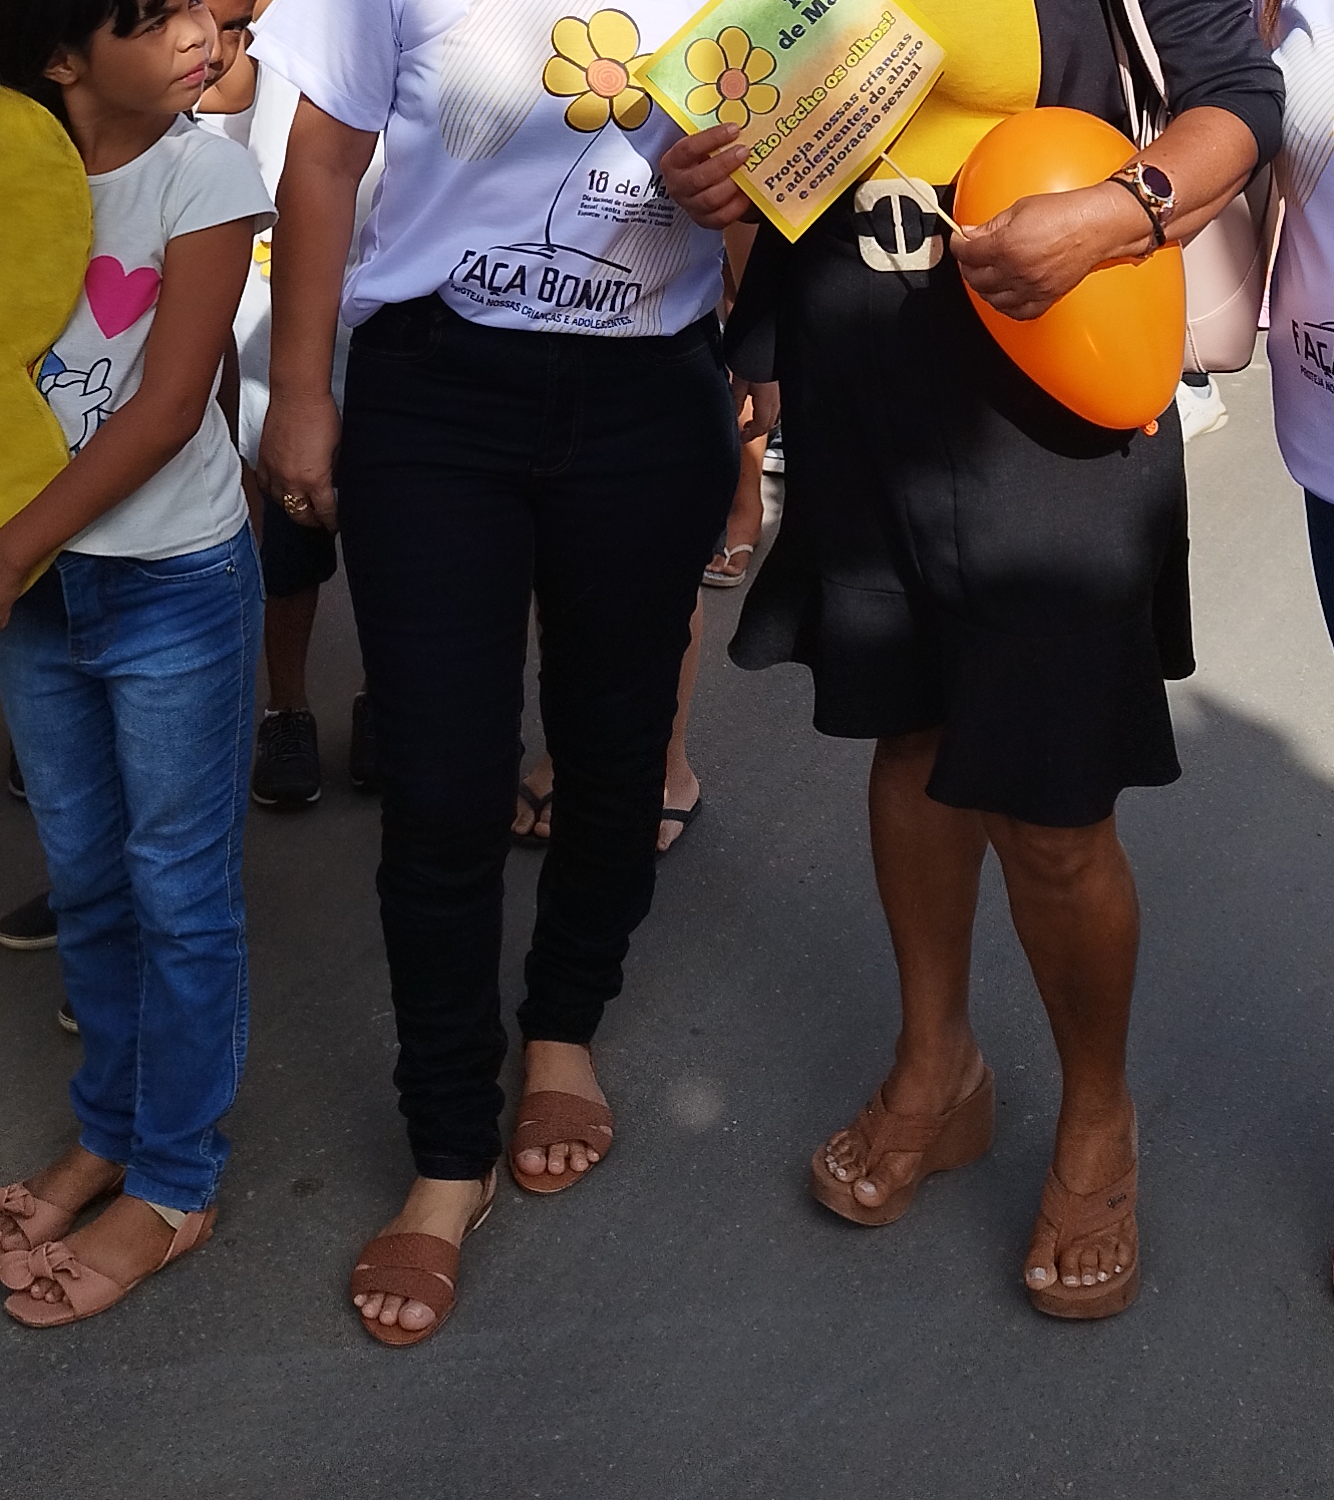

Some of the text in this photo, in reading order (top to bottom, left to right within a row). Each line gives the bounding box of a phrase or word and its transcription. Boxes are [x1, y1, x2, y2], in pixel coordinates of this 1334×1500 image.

[778, 23, 806, 50] de
[745, 10, 897, 173] Não feche os olhos!
[763, 33, 912, 191] Proteja nossas crianças
[775, 39, 924, 203] e adolescentes do abuso
[798, 63, 923, 200] e exploração sexual
[588, 168, 609, 193] 18
[615, 179, 641, 197] de
[449, 249, 527, 296] FAÇA
[521, 305, 562, 323] CRIANÇAS
[564, 316, 570, 324] E
